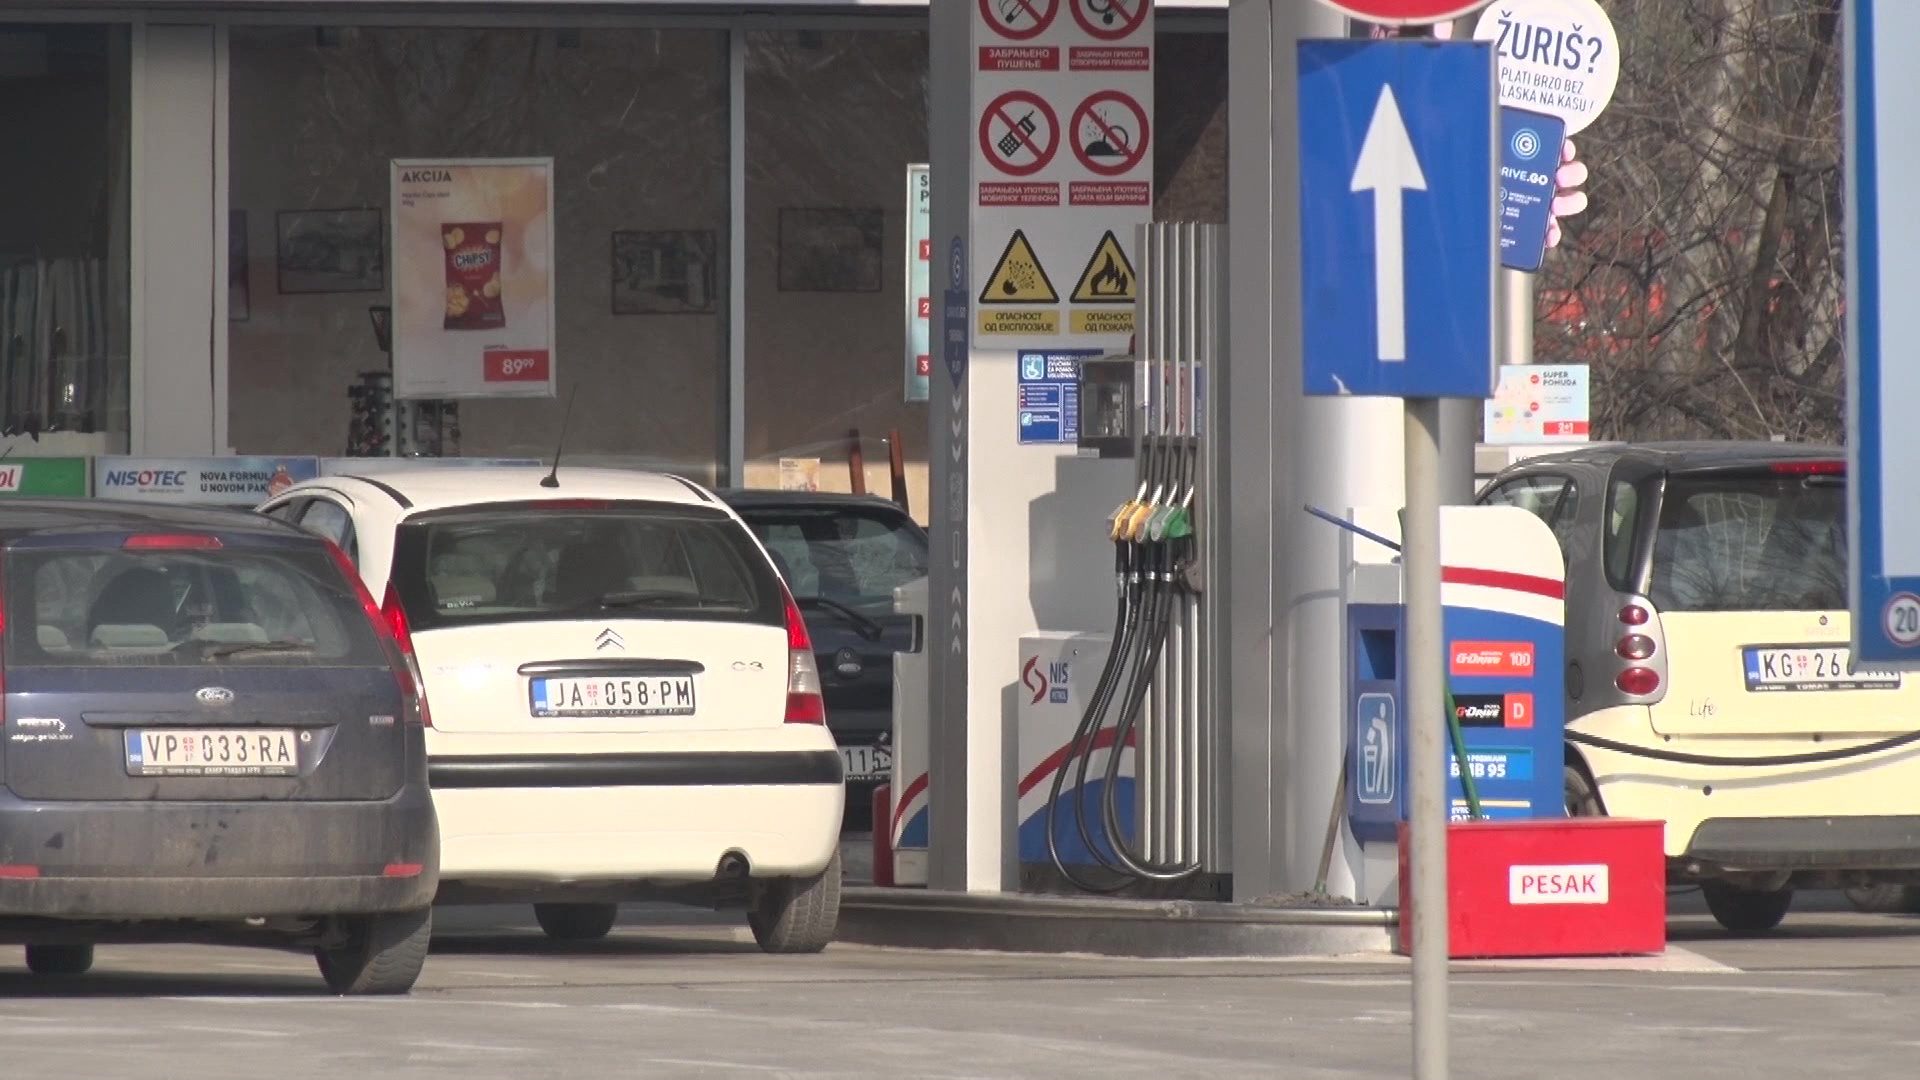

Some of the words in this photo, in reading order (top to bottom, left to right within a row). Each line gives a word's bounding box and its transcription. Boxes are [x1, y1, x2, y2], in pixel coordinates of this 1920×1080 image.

[1496, 9, 1603, 74] ŽURIŠ?
[989, 48, 1049, 58] ЗАБРАЊЕНО
[997, 59, 1041, 69] ПУШЕЊЕ
[1501, 67, 1531, 85] PLATI
[1533, 73, 1562, 91] BRZO
[1564, 79, 1584, 95] BEZ
[1539, 91, 1554, 106] NA
[402, 171, 452, 182] AKCIJA
[996, 312, 1042, 321] ОПАСНОСТ
[1087, 312, 1132, 321] ОПАСНОСТ
[984, 323, 997, 332] ОД
[999, 323, 1053, 331] ЕКСПЛОЗИЈЕ
[1084, 323, 1097, 332] ОД
[1099, 323, 1135, 332] ПОЖАРА
[106, 470, 187, 486] NISOTEC
[200, 471, 226, 481] NOVA
[201, 483, 208, 492] U
[209, 483, 245, 493] NOVOM
[1895, 607, 1918, 633] 20
[1509, 651, 1531, 666] 100
[1763, 652, 1793, 678] KG
[1050, 662, 1068, 684] NIS
[555, 682, 583, 707] JA
[1512, 702, 1525, 719] D
[147, 734, 177, 762] VP
[1487, 762, 1506, 778] 95
[1522, 874, 1596, 894] PESAK
